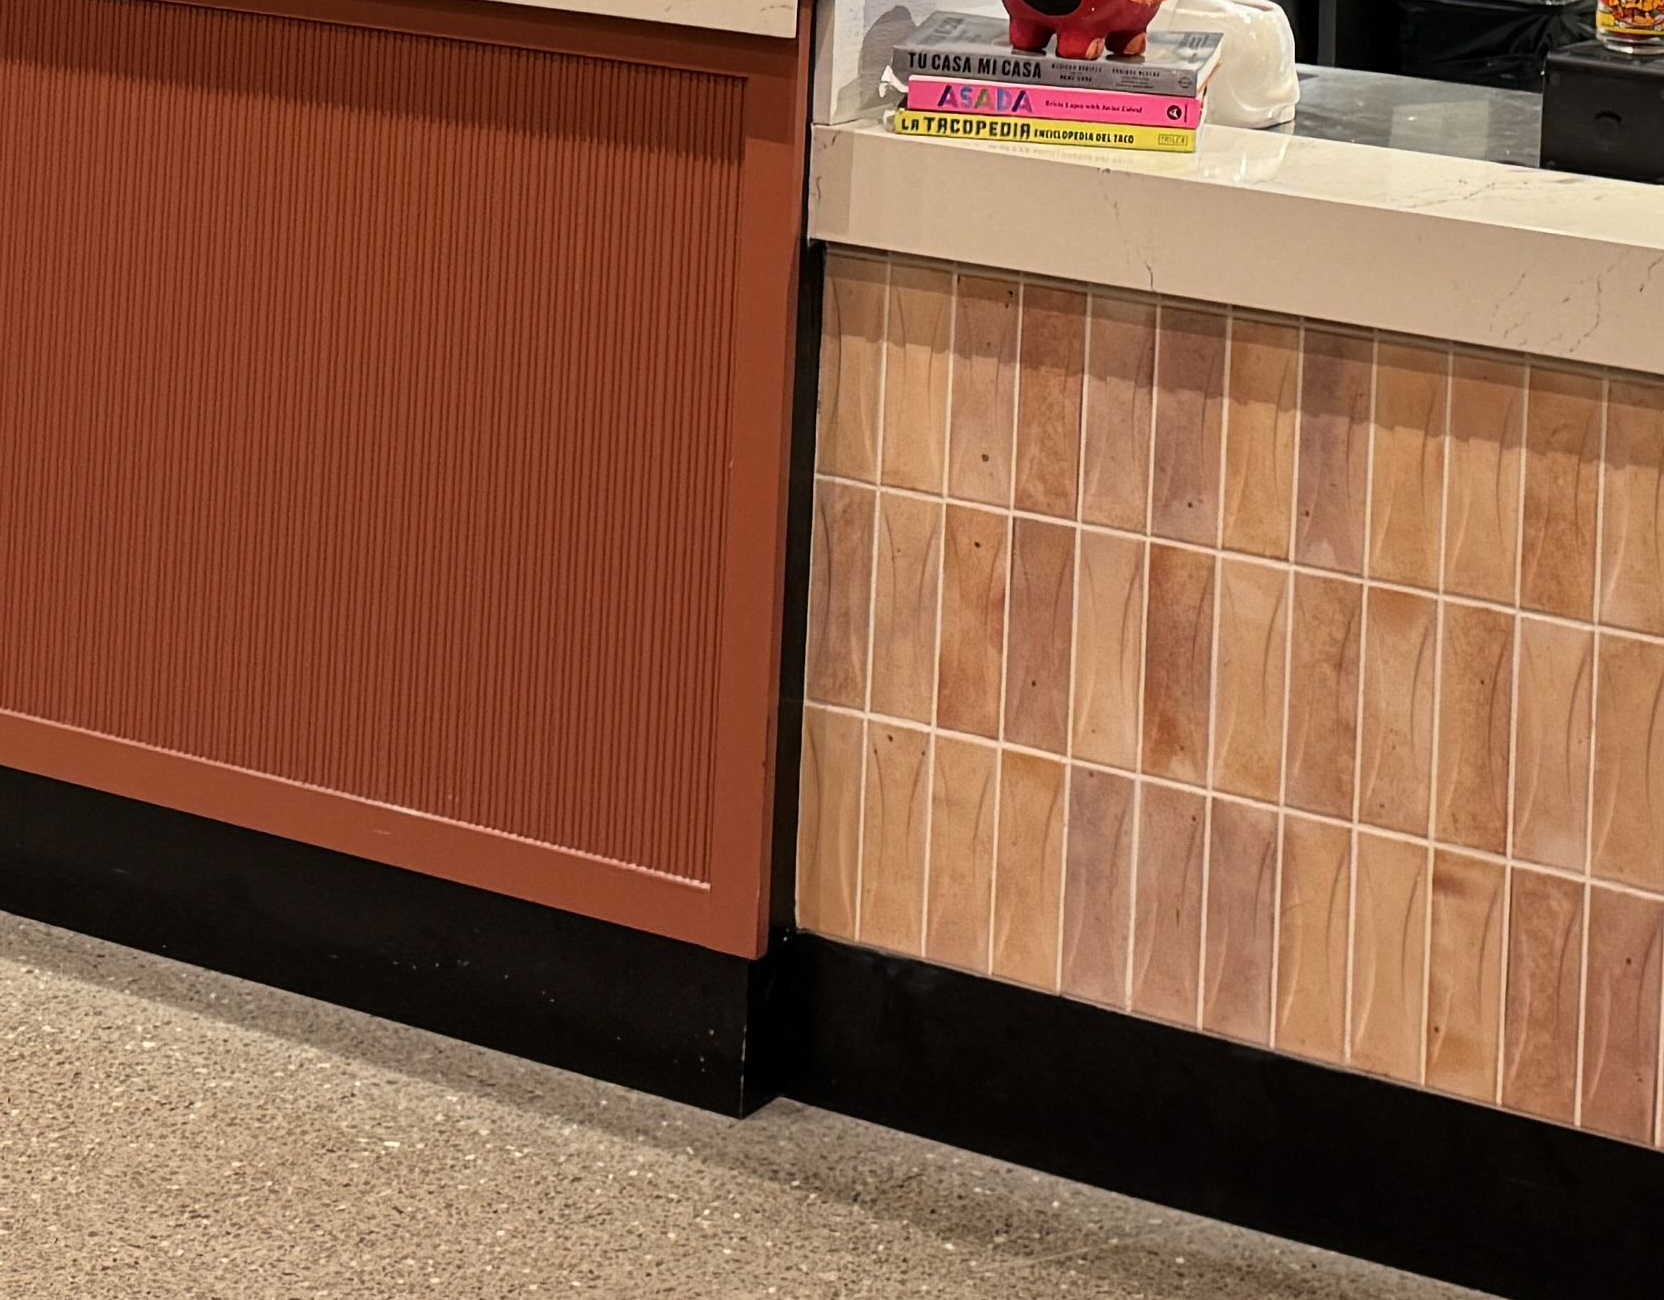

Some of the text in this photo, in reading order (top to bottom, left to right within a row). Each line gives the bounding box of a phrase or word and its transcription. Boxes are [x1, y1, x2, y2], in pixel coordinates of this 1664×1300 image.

[908, 52, 928, 69] TU
[931, 54, 972, 73] CASA
[977, 57, 997, 75] MI
[1001, 60, 1042, 79] CASA
[937, 84, 1034, 113] ASADA
[901, 118, 920, 131] LA
[923, 116, 1031, 139] TACOPEDIA
[1034, 128, 1094, 141] ENCICLOPEDIA
[1095, 131, 1111, 143] DEL
[1113, 132, 1135, 144] TACO
